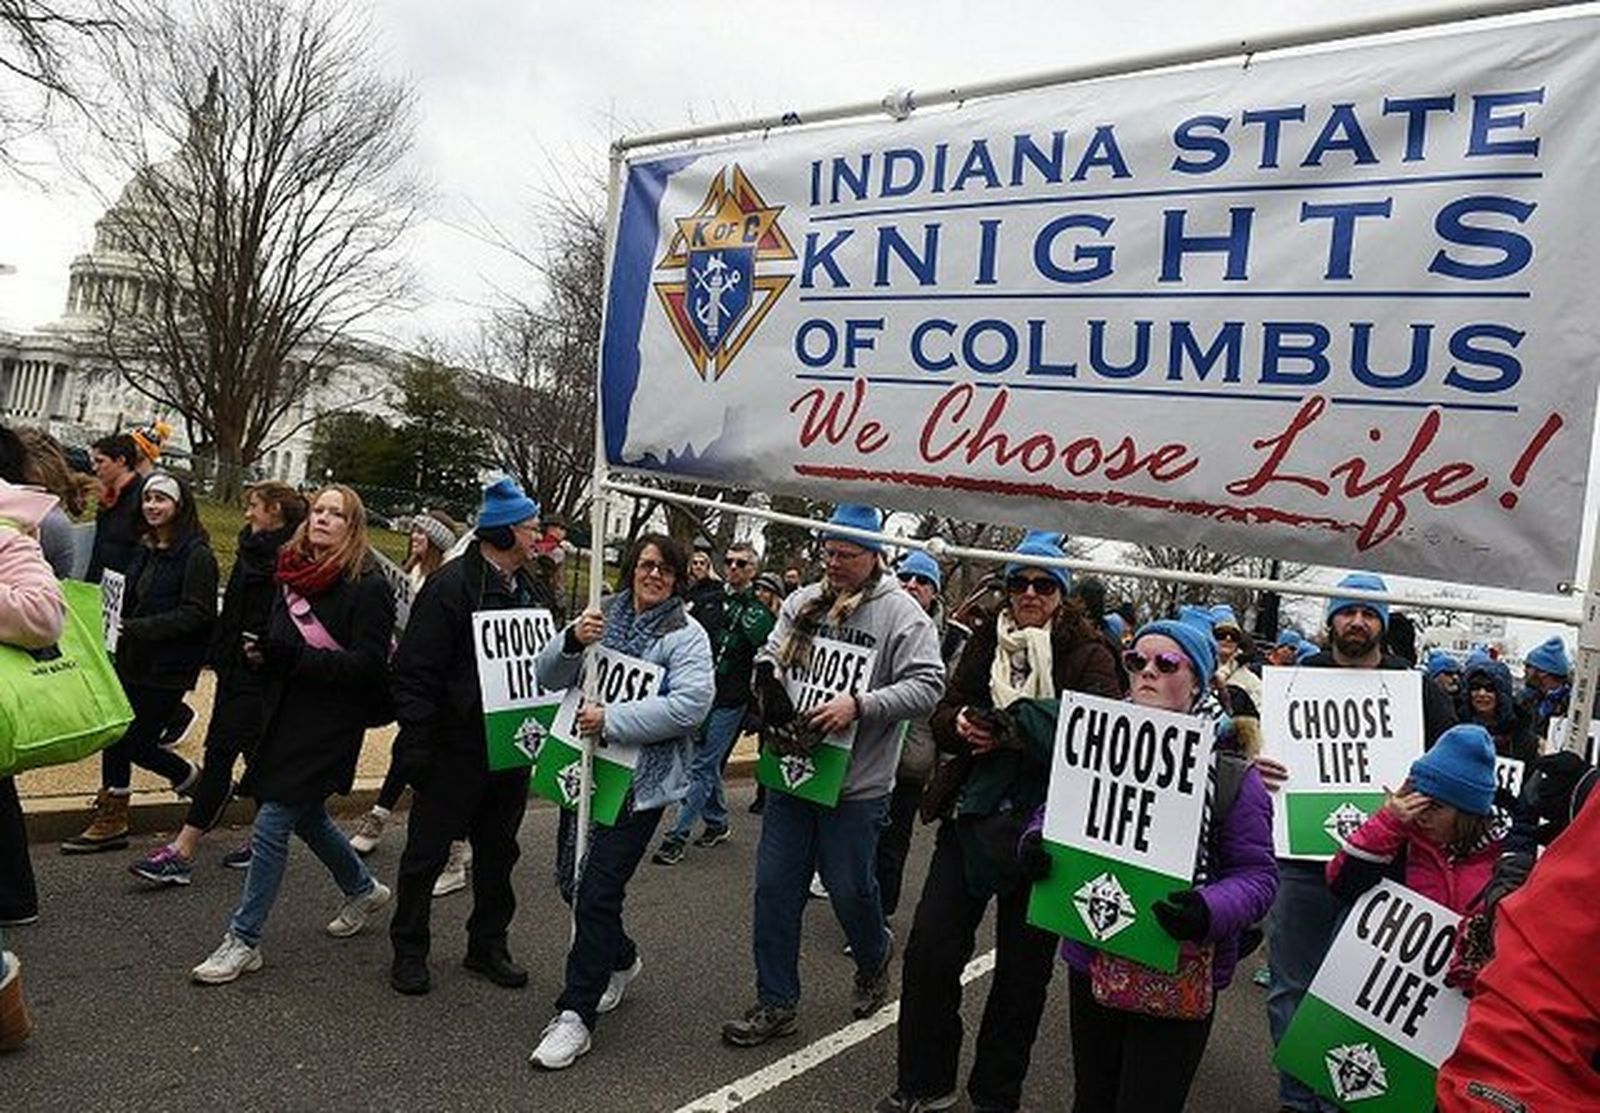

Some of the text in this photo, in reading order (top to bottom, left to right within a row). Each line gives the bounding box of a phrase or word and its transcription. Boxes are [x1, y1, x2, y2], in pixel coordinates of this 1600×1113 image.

[809, 87, 1546, 206] INDIANA STATE
[692, 222, 710, 247] K
[743, 215, 761, 243] C
[800, 195, 1538, 289] KNIGHTS
[794, 317, 1527, 394] OF COLUMBUS
[790, 379, 1564, 551] We Choose Life!
[506, 659, 546, 701] LIF
[1288, 697, 1394, 742] CHOOSE
[1064, 705, 1201, 796] CHOOSE
[1317, 741, 1372, 784] LIFE
[1085, 775, 1157, 854] LIFE
[1355, 955, 1440, 1039] LIFE
